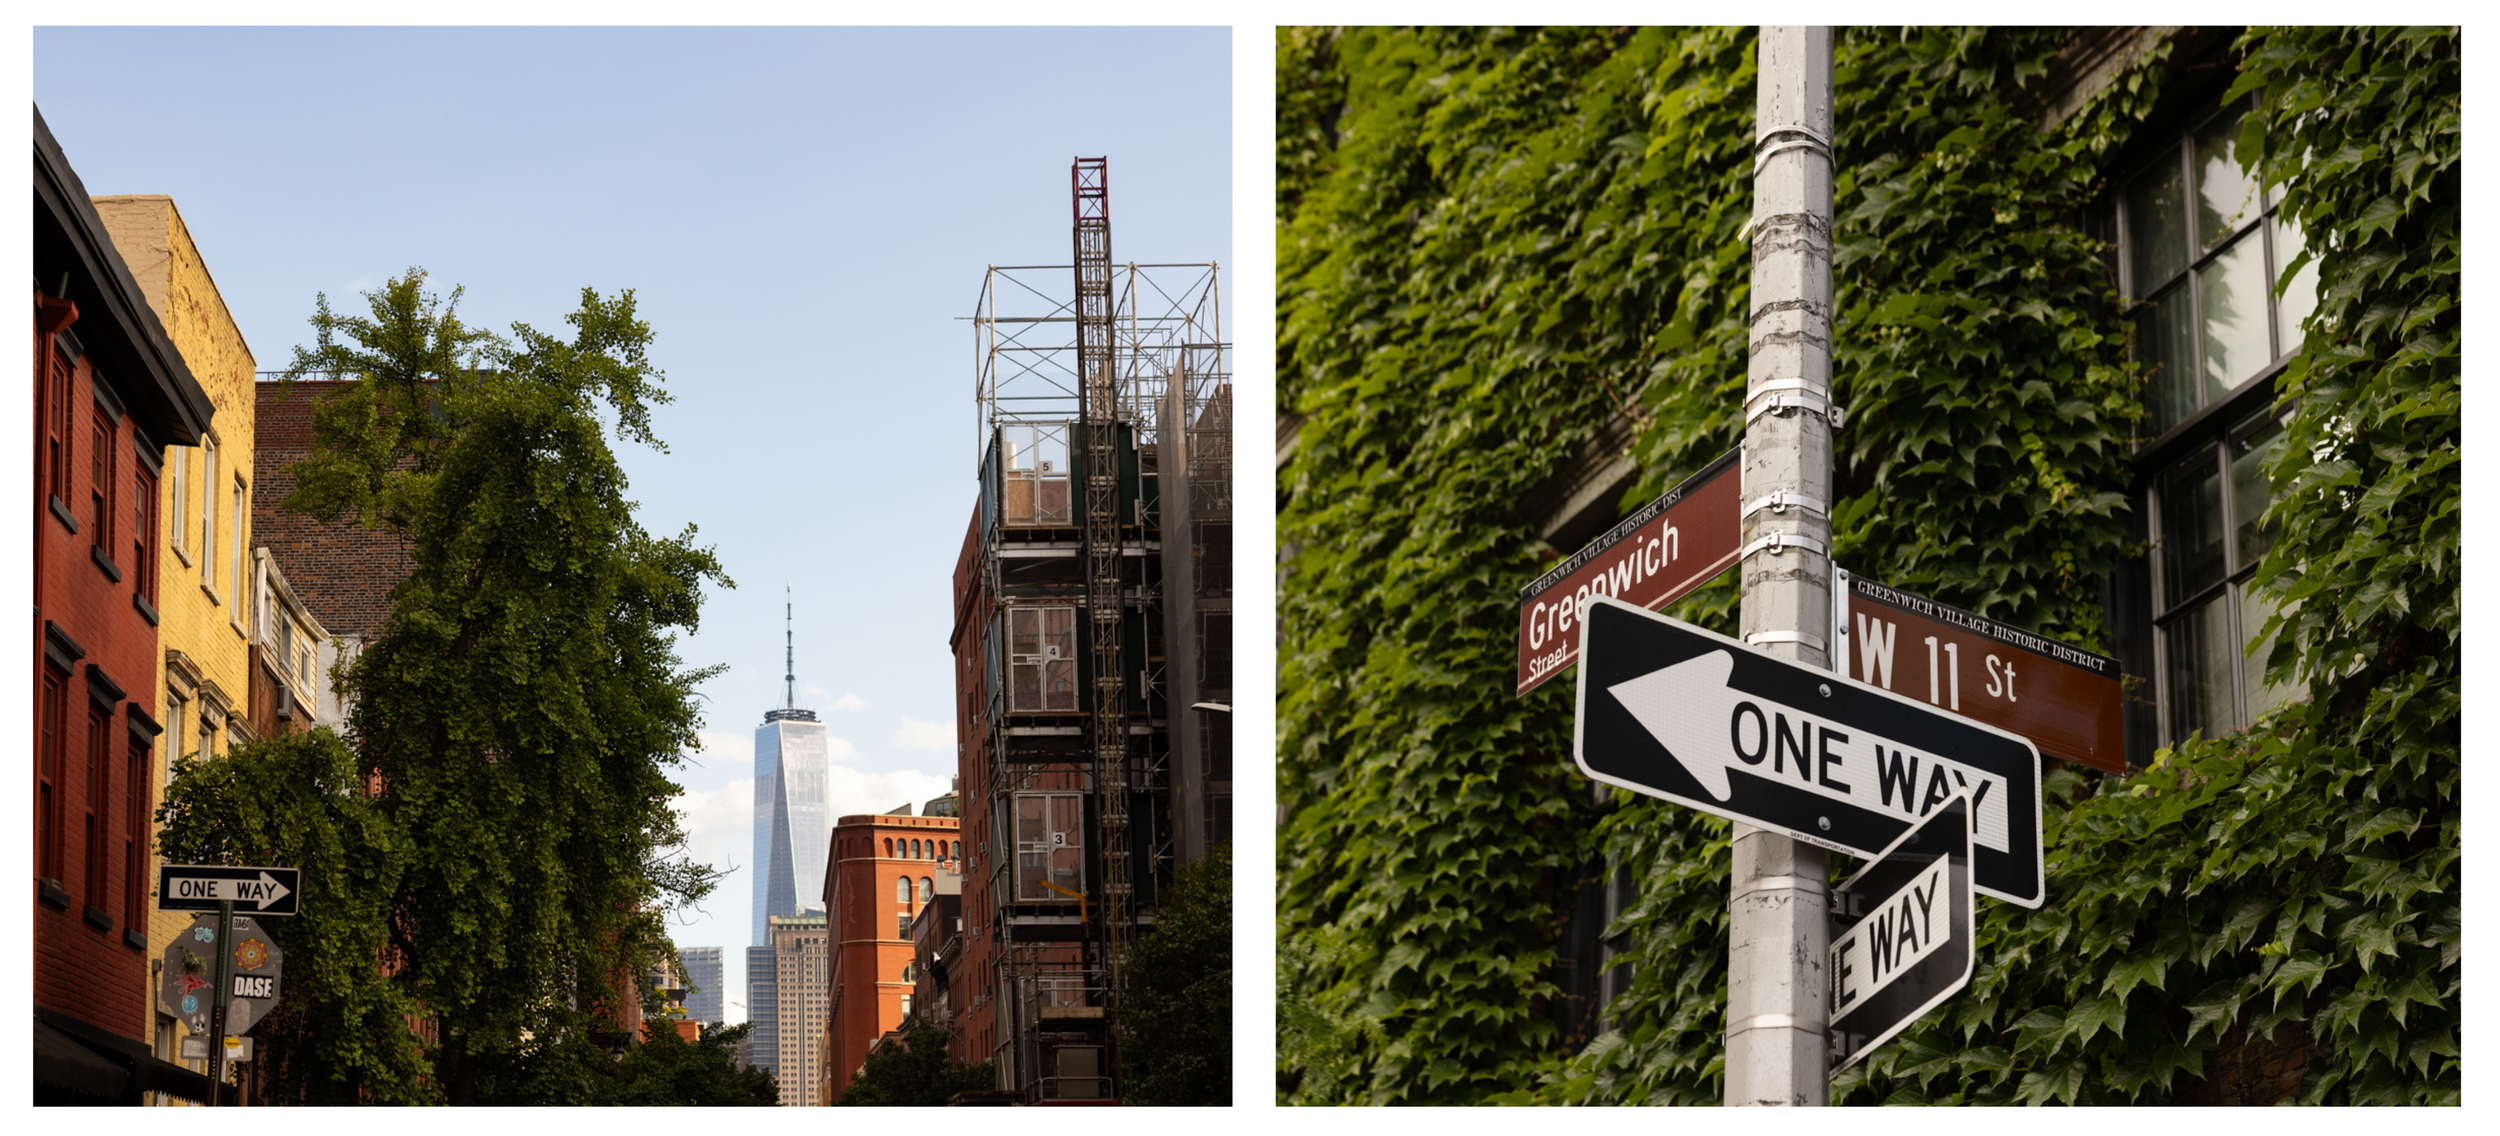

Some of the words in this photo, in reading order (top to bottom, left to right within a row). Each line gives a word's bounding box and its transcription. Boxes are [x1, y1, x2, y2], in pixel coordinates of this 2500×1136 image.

[1043, 463, 1049, 471] 5
[1531, 557, 1581, 597] GREENWICH
[1582, 529, 1620, 560] VILLAGE
[1621, 505, 1661, 535] HISTORIC
[1663, 487, 1683, 509] DIST
[1529, 518, 1680, 651] Greenwich
[1857, 580, 1934, 616] GREENWICH
[1937, 606, 1990, 634] VILLAGE
[1993, 624, 2049, 654] HISTORIC
[2052, 644, 2106, 672] DISTRICT
[1050, 648, 1056, 656] 4
[1528, 638, 1567, 683] Street
[1856, 612, 1897, 690] W
[1924, 635, 1960, 711] 11
[1985, 653, 2017, 703] St
[1730, 700, 1851, 795] ONE
[1875, 743, 1992, 835] WAY
[1055, 834, 1063, 844] 3
[1811, 838, 1855, 856] TRANSPORTATION
[179, 880, 218, 898] ONE
[236, 882, 277, 899] WAY
[1869, 870, 1939, 984] WAY
[233, 976, 272, 997] DASE
